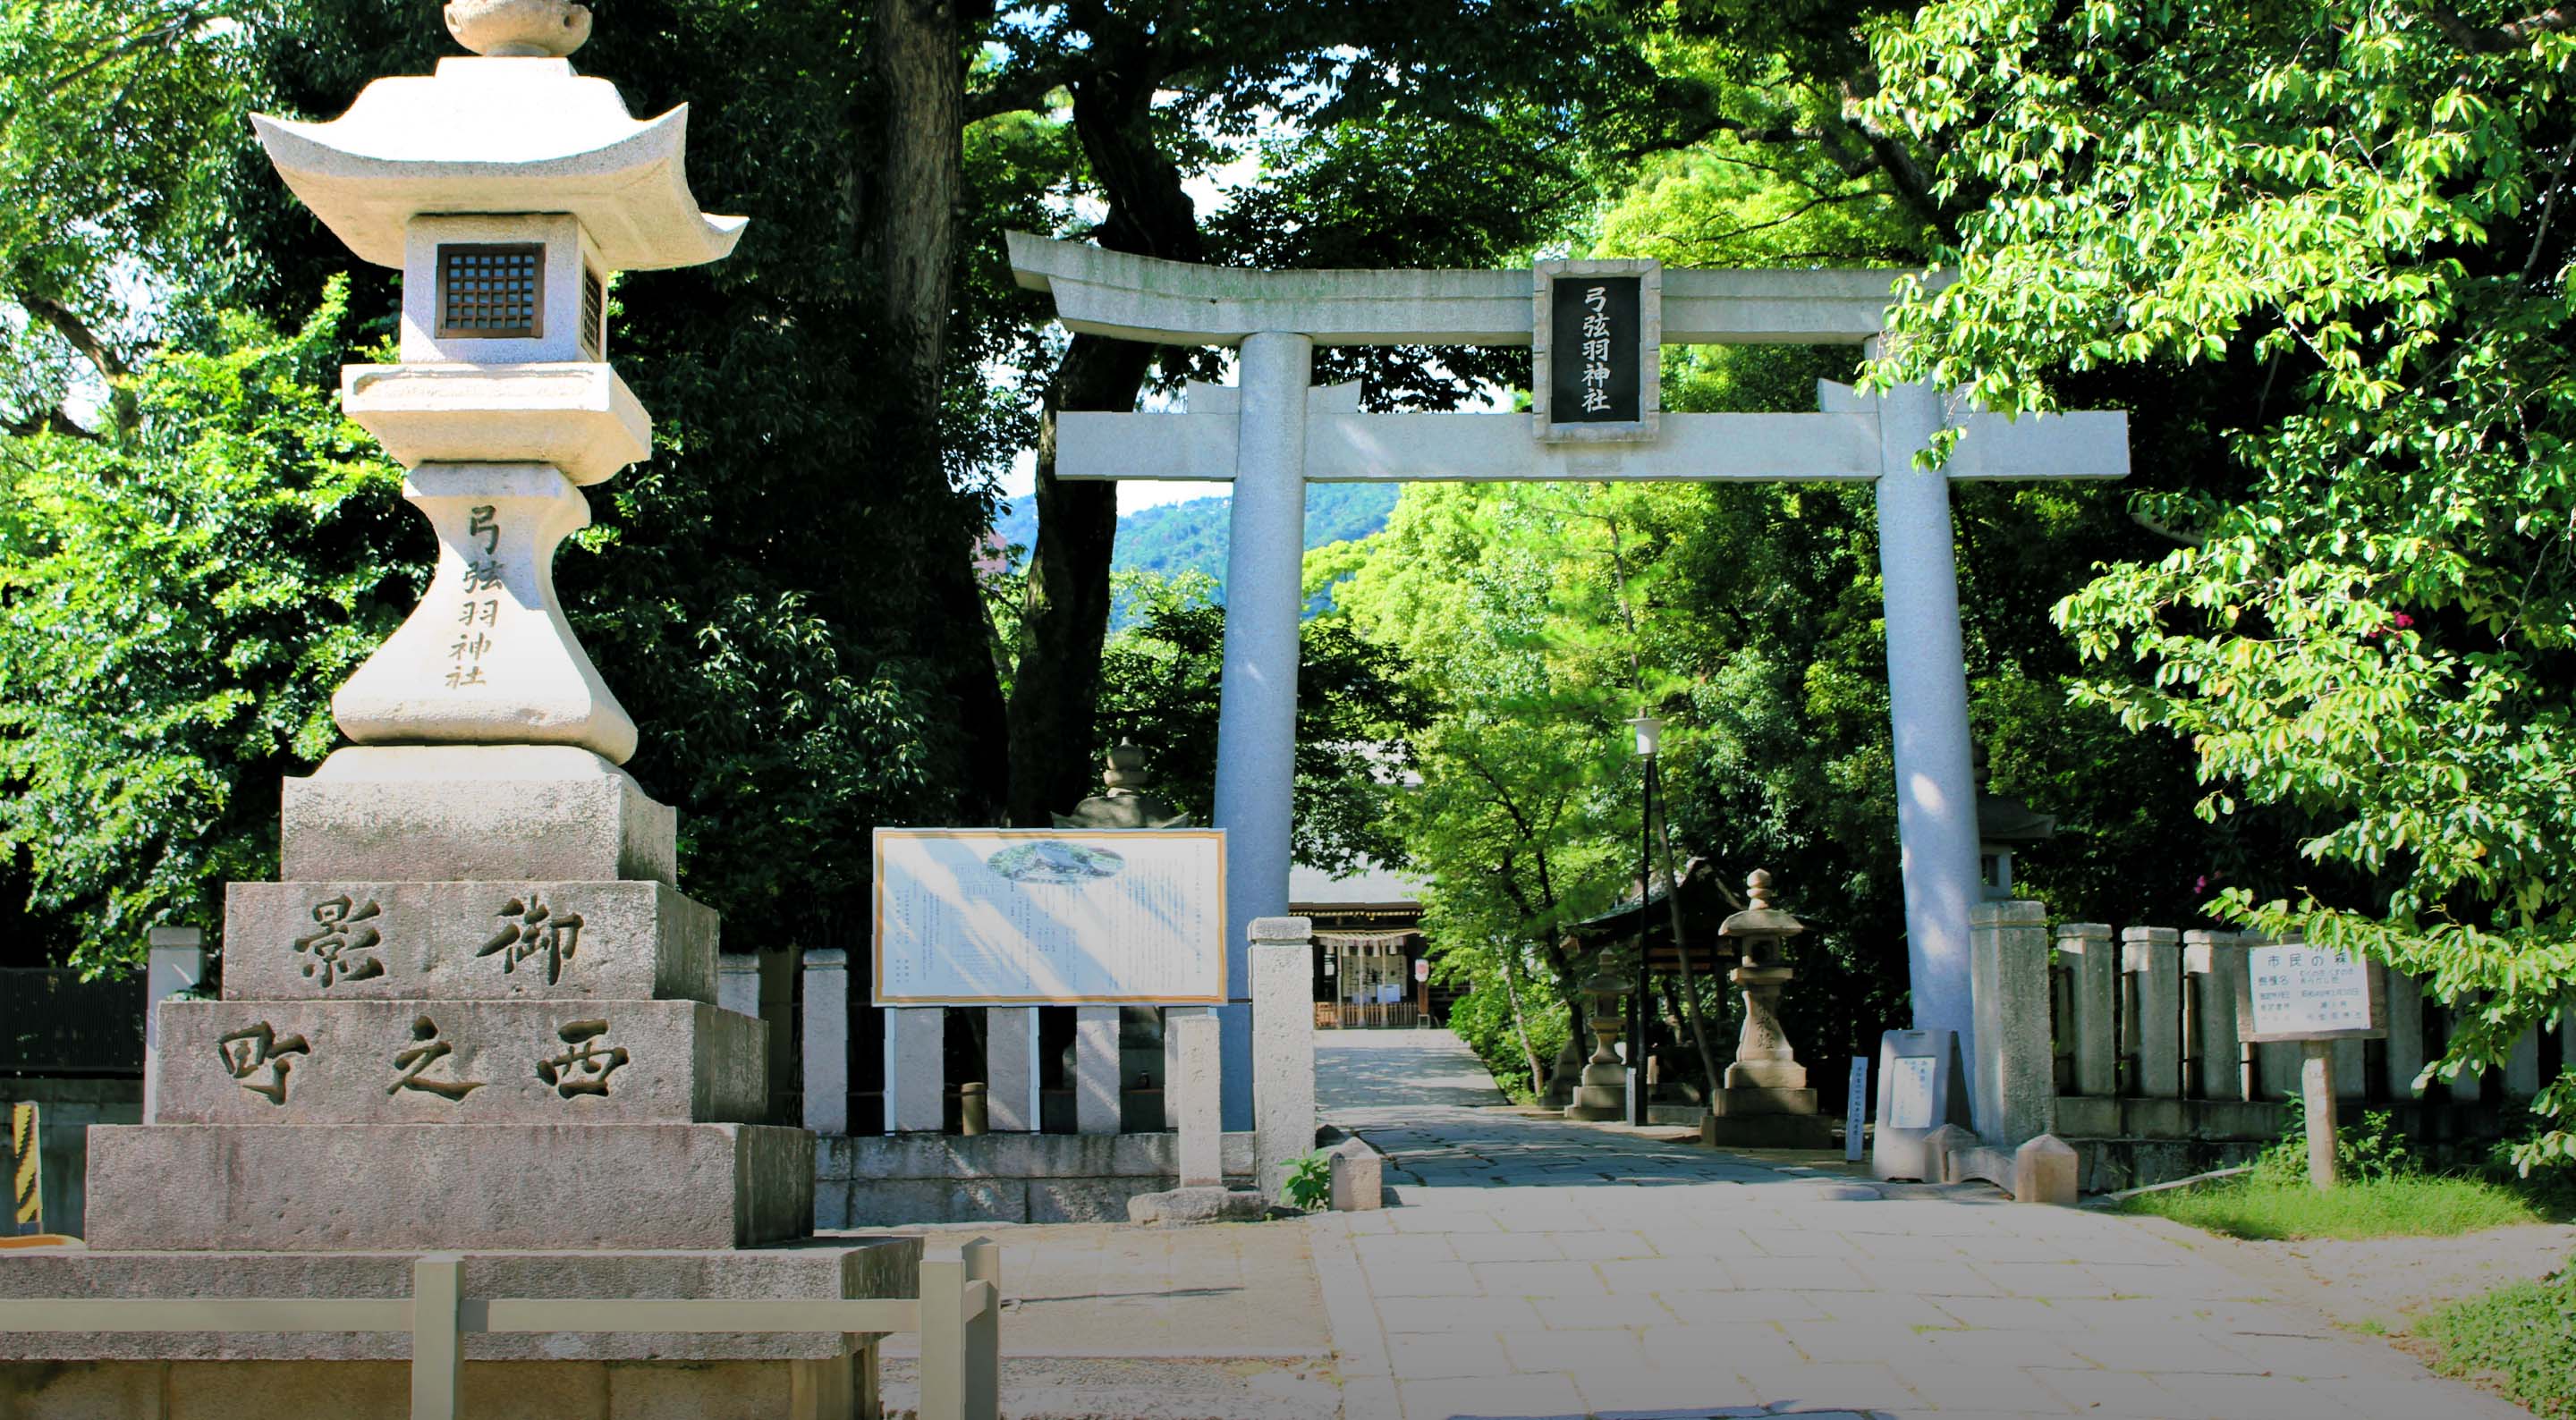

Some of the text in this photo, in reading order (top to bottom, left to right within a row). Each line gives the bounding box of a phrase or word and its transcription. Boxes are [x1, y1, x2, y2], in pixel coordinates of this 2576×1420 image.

[1581, 287, 1611, 414] 弓弦羽神社
[445, 504, 506, 690] 弓弦羽神社
[294, 894, 585, 988] 御影
[2267, 951, 2348, 968] 市民の森
[217, 1015, 631, 1106] 西之町
